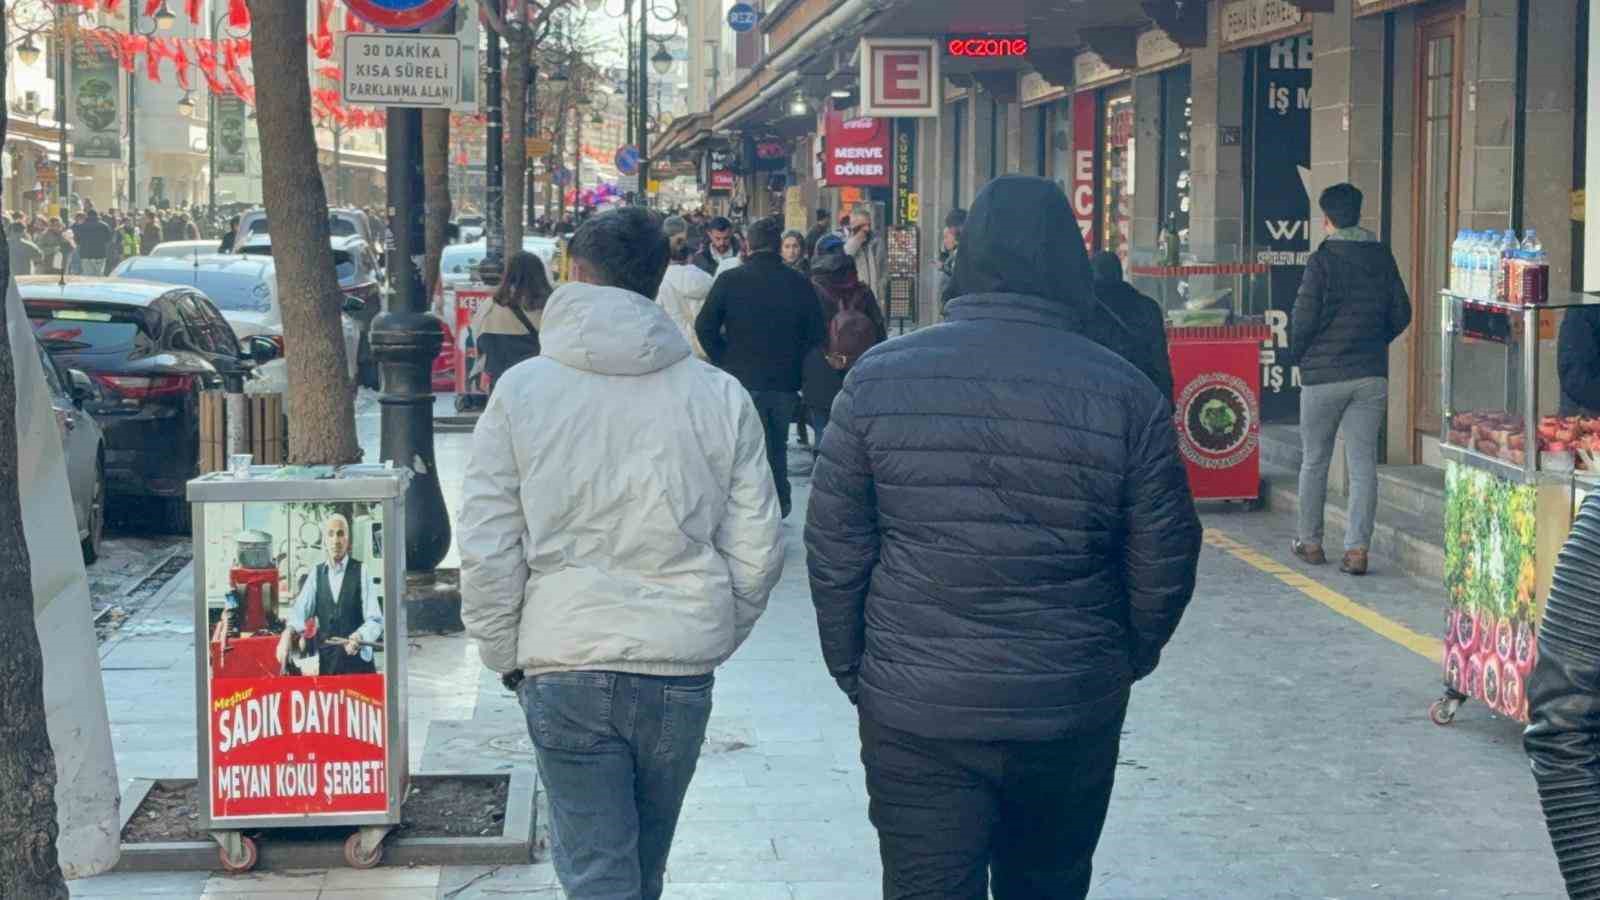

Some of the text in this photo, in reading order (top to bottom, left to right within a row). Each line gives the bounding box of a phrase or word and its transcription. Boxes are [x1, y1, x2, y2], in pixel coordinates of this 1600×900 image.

[362, 42, 441, 58] 30 DAKİKA
[949, 39, 1028, 56] eczane
[356, 62, 449, 79] KISA SÜRELİ
[883, 54, 921, 100] E
[350, 82, 453, 98] PARKLANMA ALANI
[1268, 81, 1290, 115] İŞ
[834, 147, 883, 158] MERVE
[834, 160, 884, 176] DÖNER
[218, 690, 383, 753] SADIK DAYI'NIN
[218, 752, 385, 804] MEYAN KÖKÜ ŞERBETİ
